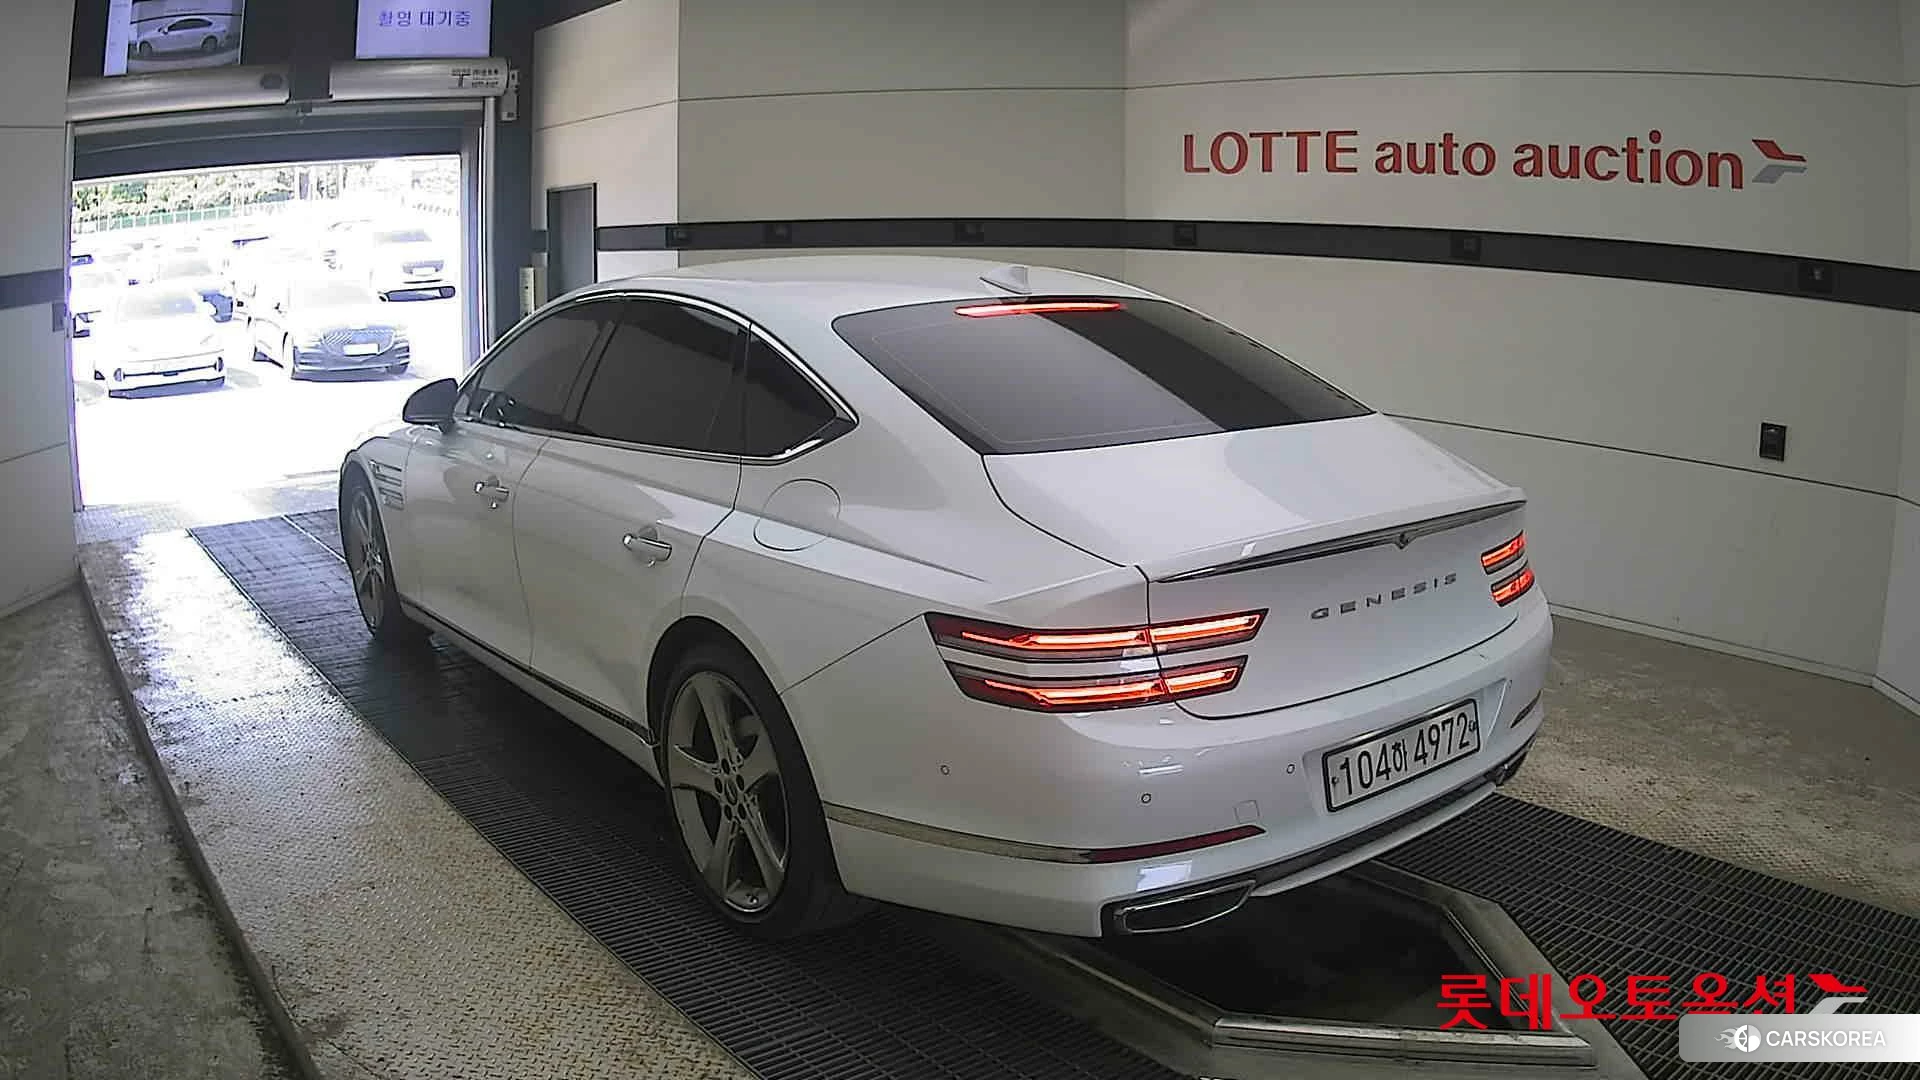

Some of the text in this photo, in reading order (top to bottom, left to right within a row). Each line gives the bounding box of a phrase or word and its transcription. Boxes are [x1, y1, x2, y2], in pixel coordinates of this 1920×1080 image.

[420, 10, 471, 27] 대기중
[1183, 129, 1744, 189] LOTTE auto auction
[1310, 573, 1457, 619] GENESIS
[1339, 712, 1470, 796] 104하 4972
